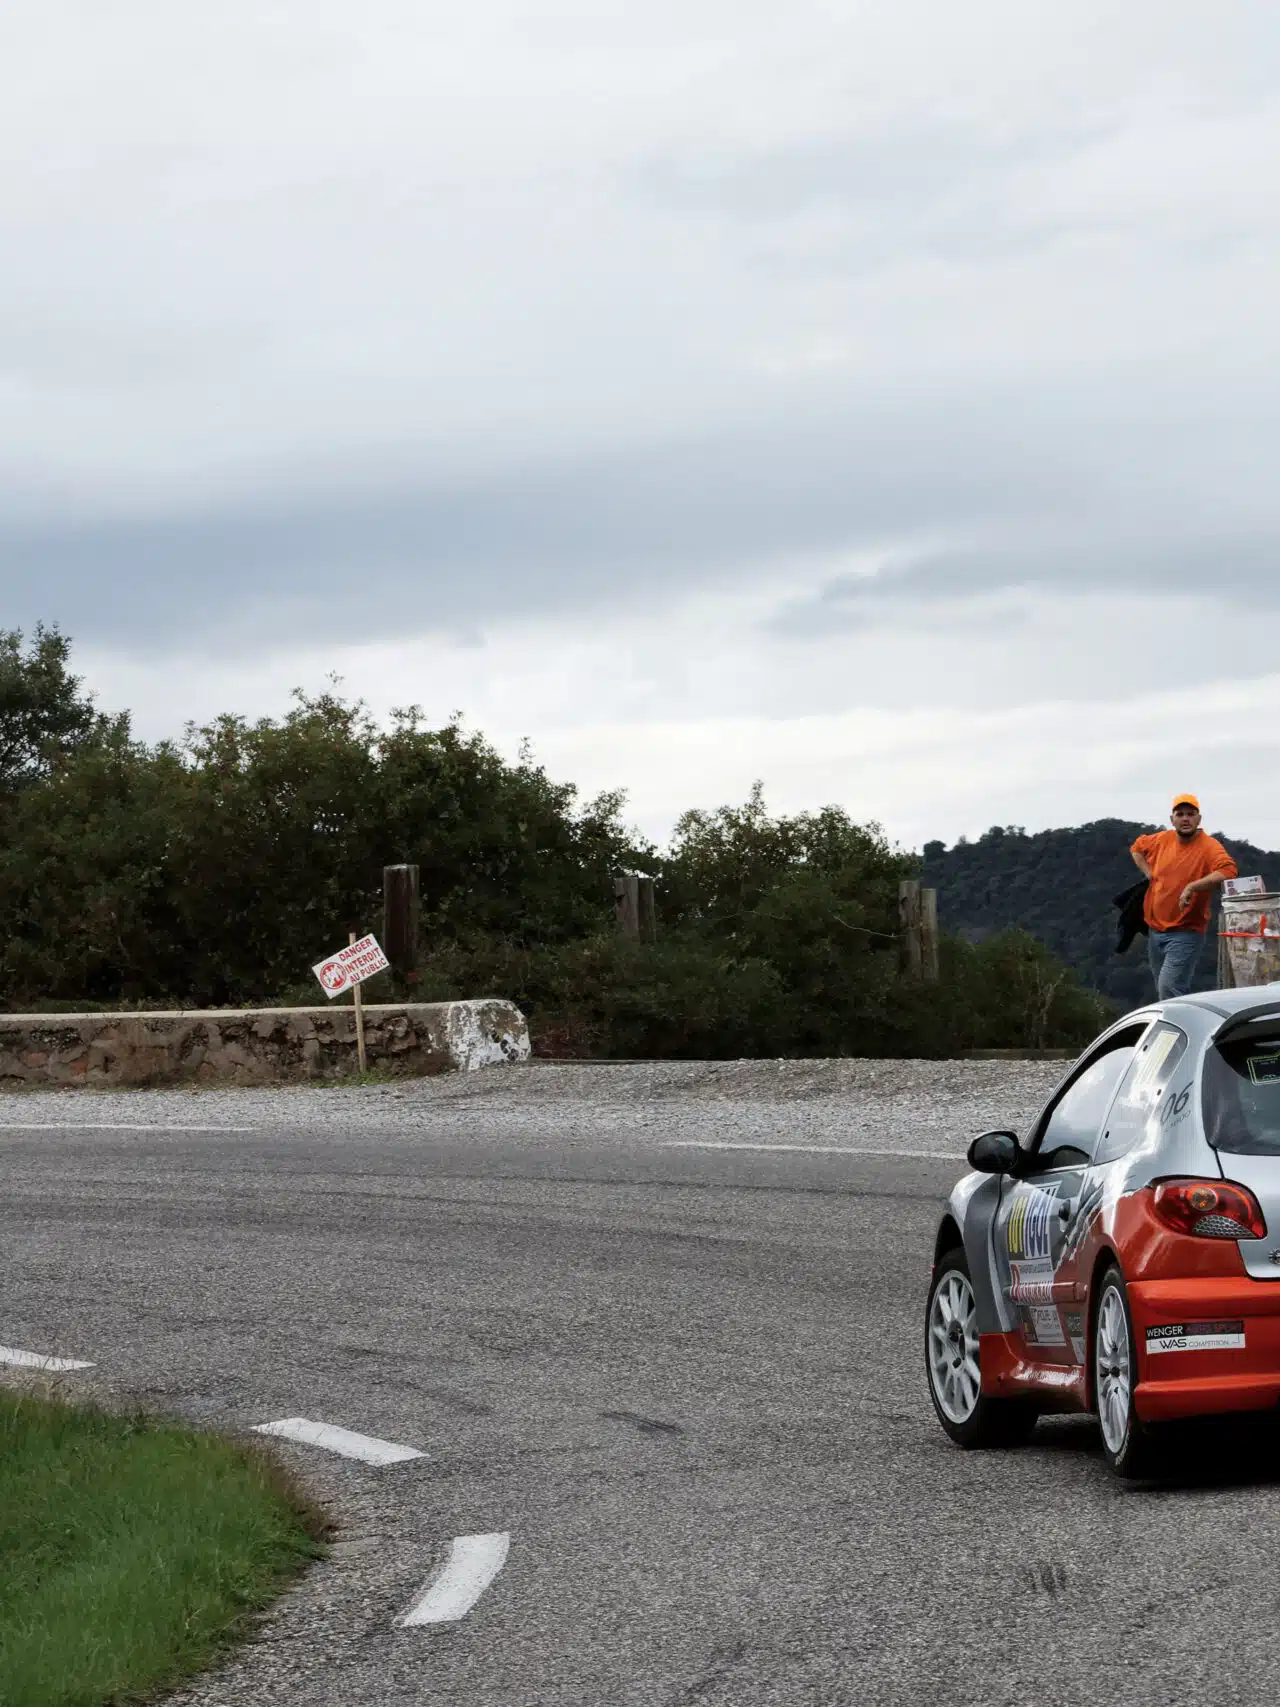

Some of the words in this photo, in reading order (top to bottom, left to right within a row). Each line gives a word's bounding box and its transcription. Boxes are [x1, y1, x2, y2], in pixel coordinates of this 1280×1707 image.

[338, 938, 373, 962] DANGER
[344, 947, 380, 973] INTERDIT
[349, 974, 361, 984] AU
[360, 957, 387, 978] PUBLIC
[1146, 1325, 1184, 1337] WENGER
[1159, 1338, 1188, 1349] WAS
